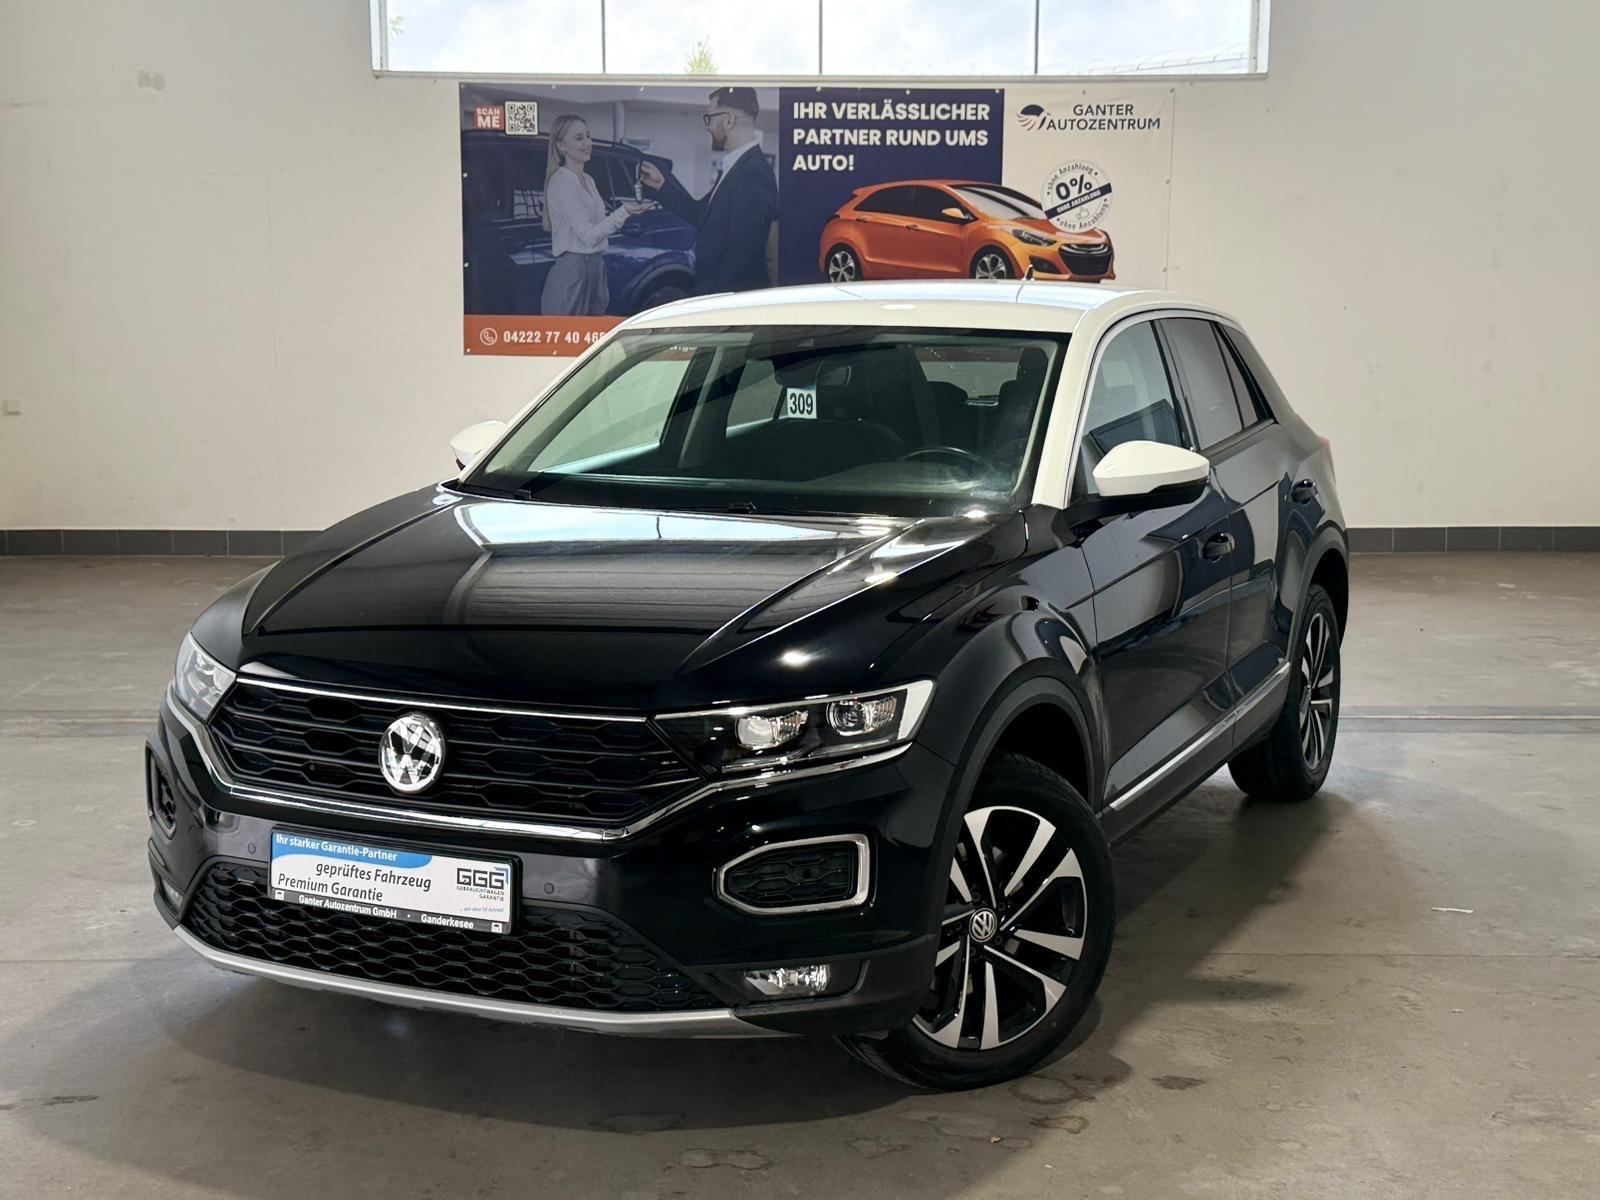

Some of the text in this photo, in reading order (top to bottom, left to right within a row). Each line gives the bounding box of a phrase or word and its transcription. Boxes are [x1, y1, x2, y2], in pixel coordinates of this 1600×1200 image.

[476, 107, 500, 116] SCAN
[793, 99, 990, 121] IHR VERLÄSSLICHER
[1073, 104, 1134, 116] GANTER
[477, 116, 500, 128] ME
[1046, 118, 1160, 130] AUTOZENTRUM
[793, 128, 989, 146] PARTNER RUND UMS
[792, 154, 855, 171] AUTO!
[1059, 163, 1094, 175] Anzahlung
[1056, 174, 1092, 200] 0%
[503, 330, 541, 344] 04222
[546, 331, 561, 344] 77
[564, 331, 580, 344] 40
[789, 392, 814, 415] 309
[276, 833, 397, 861] Ihr starker Garantie-Partner
[316, 861, 432, 892] geprüftes Fahrzeug
[457, 867, 504, 890] GGG
[278, 873, 383, 902] Premium Garantie
[299, 895, 474, 929] Ganter Autozentrum GmbH Ganderkesee
